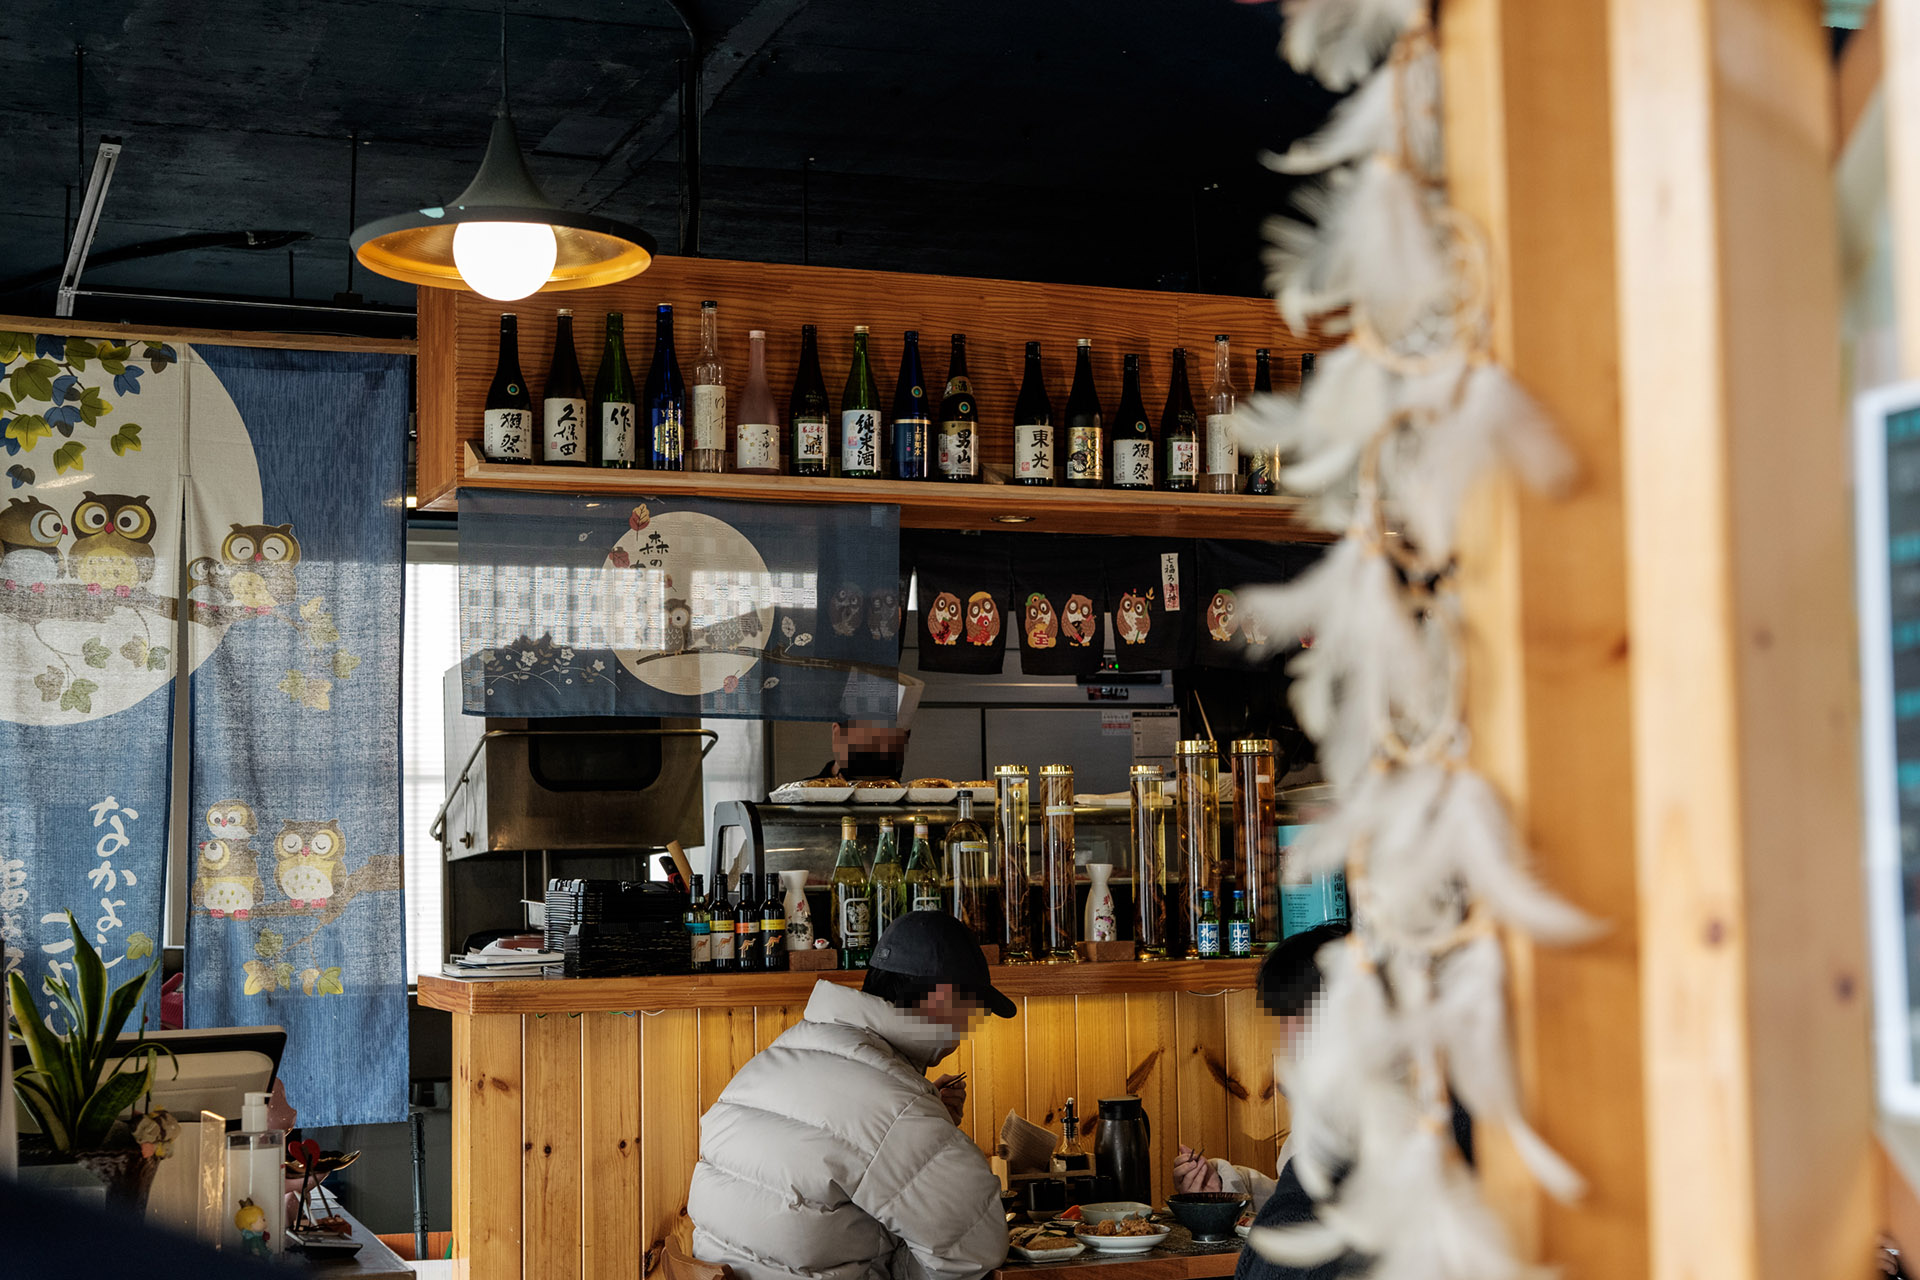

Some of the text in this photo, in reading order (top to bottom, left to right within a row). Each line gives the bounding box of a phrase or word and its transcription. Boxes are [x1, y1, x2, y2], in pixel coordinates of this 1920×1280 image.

[500, 412, 523, 454] 獺祭
[553, 403, 579, 456] 久保田
[610, 405, 632, 432] 作
[761, 429, 771, 462] さゆり
[855, 413, 875, 467] 純米酒
[956, 429, 972, 464] 男山
[1031, 429, 1050, 469] 東光
[1132, 442, 1150, 480] 獺祭
[1033, 630, 1049, 645] 宝
[88, 795, 139, 969] なかよし
[1233, 928, 1249, 939] 대선
